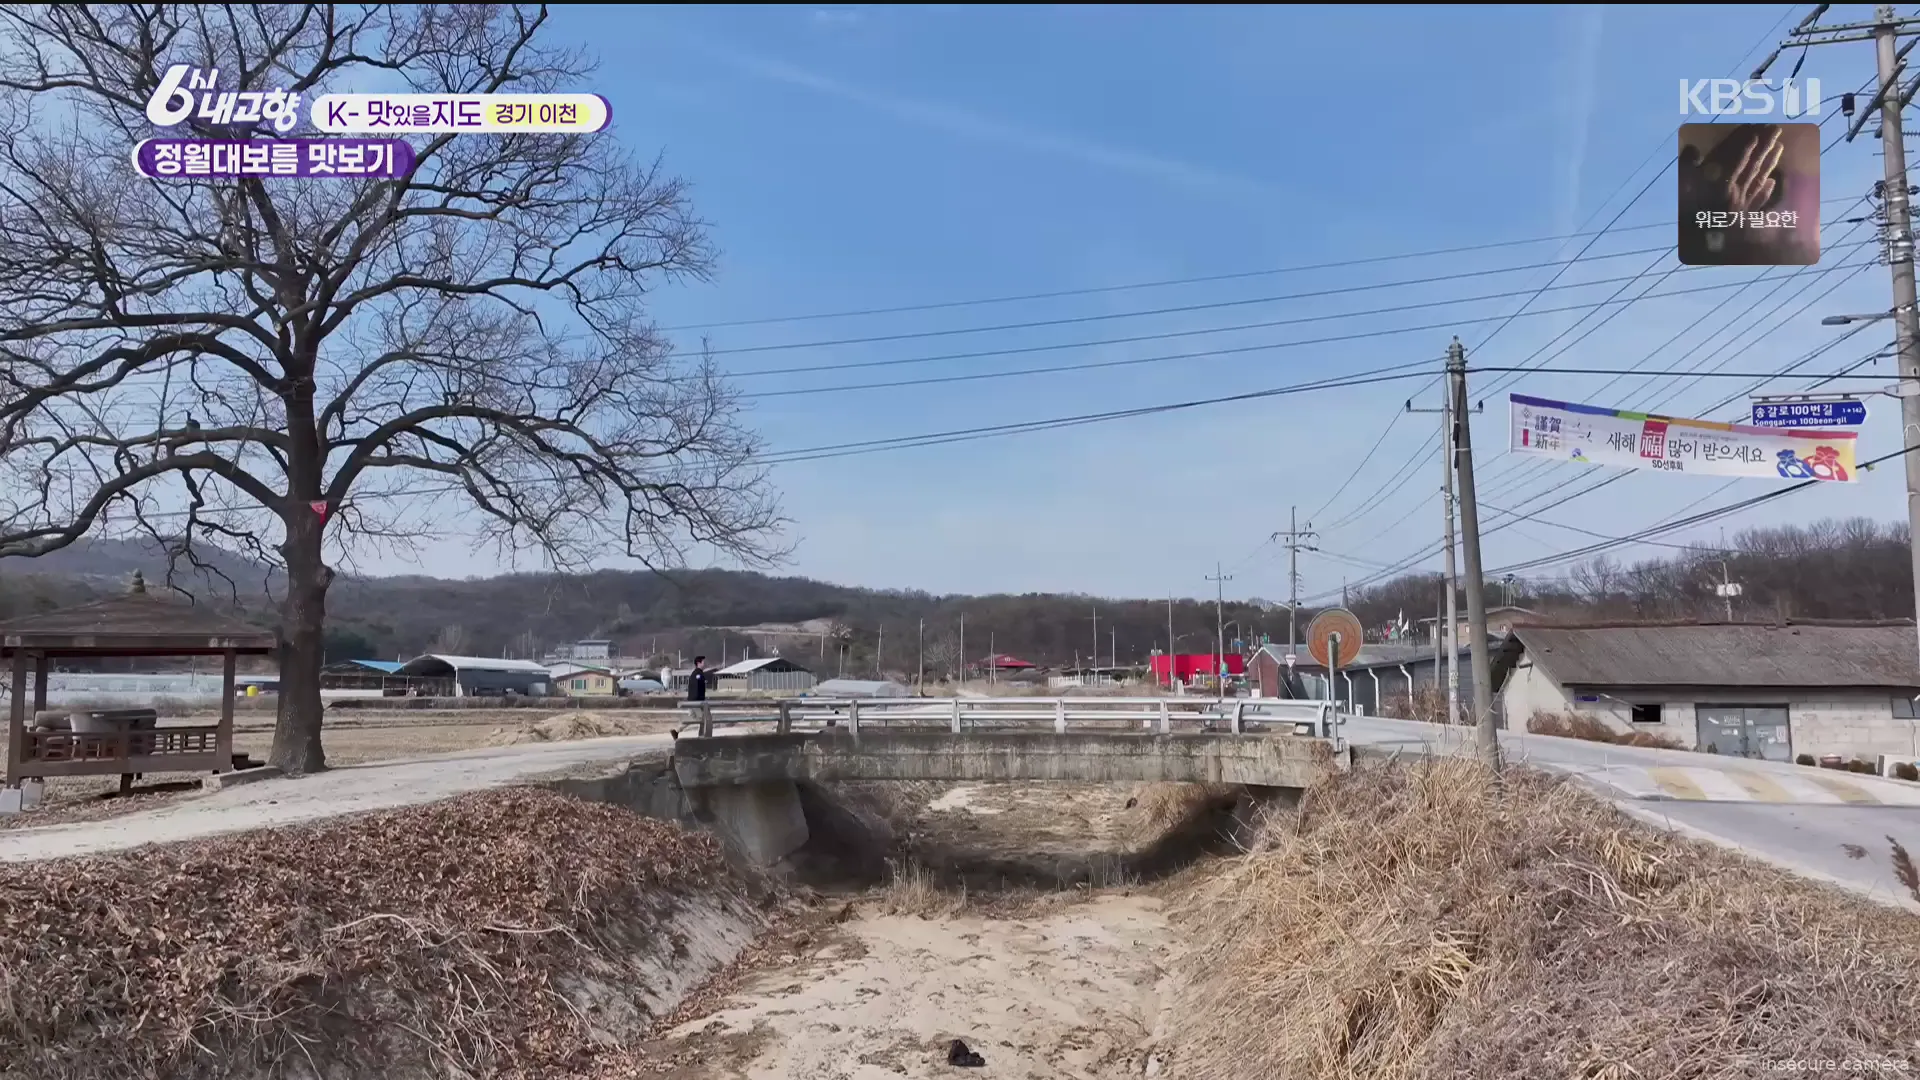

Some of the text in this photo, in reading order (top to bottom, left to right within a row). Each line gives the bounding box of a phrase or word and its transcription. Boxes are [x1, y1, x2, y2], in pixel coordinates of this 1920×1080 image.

[1606, 432, 1636, 453] 새해
[1640, 430, 1664, 457] 福
[1668, 438, 1697, 460] 많이
[1703, 441, 1766, 463] 받으세요
